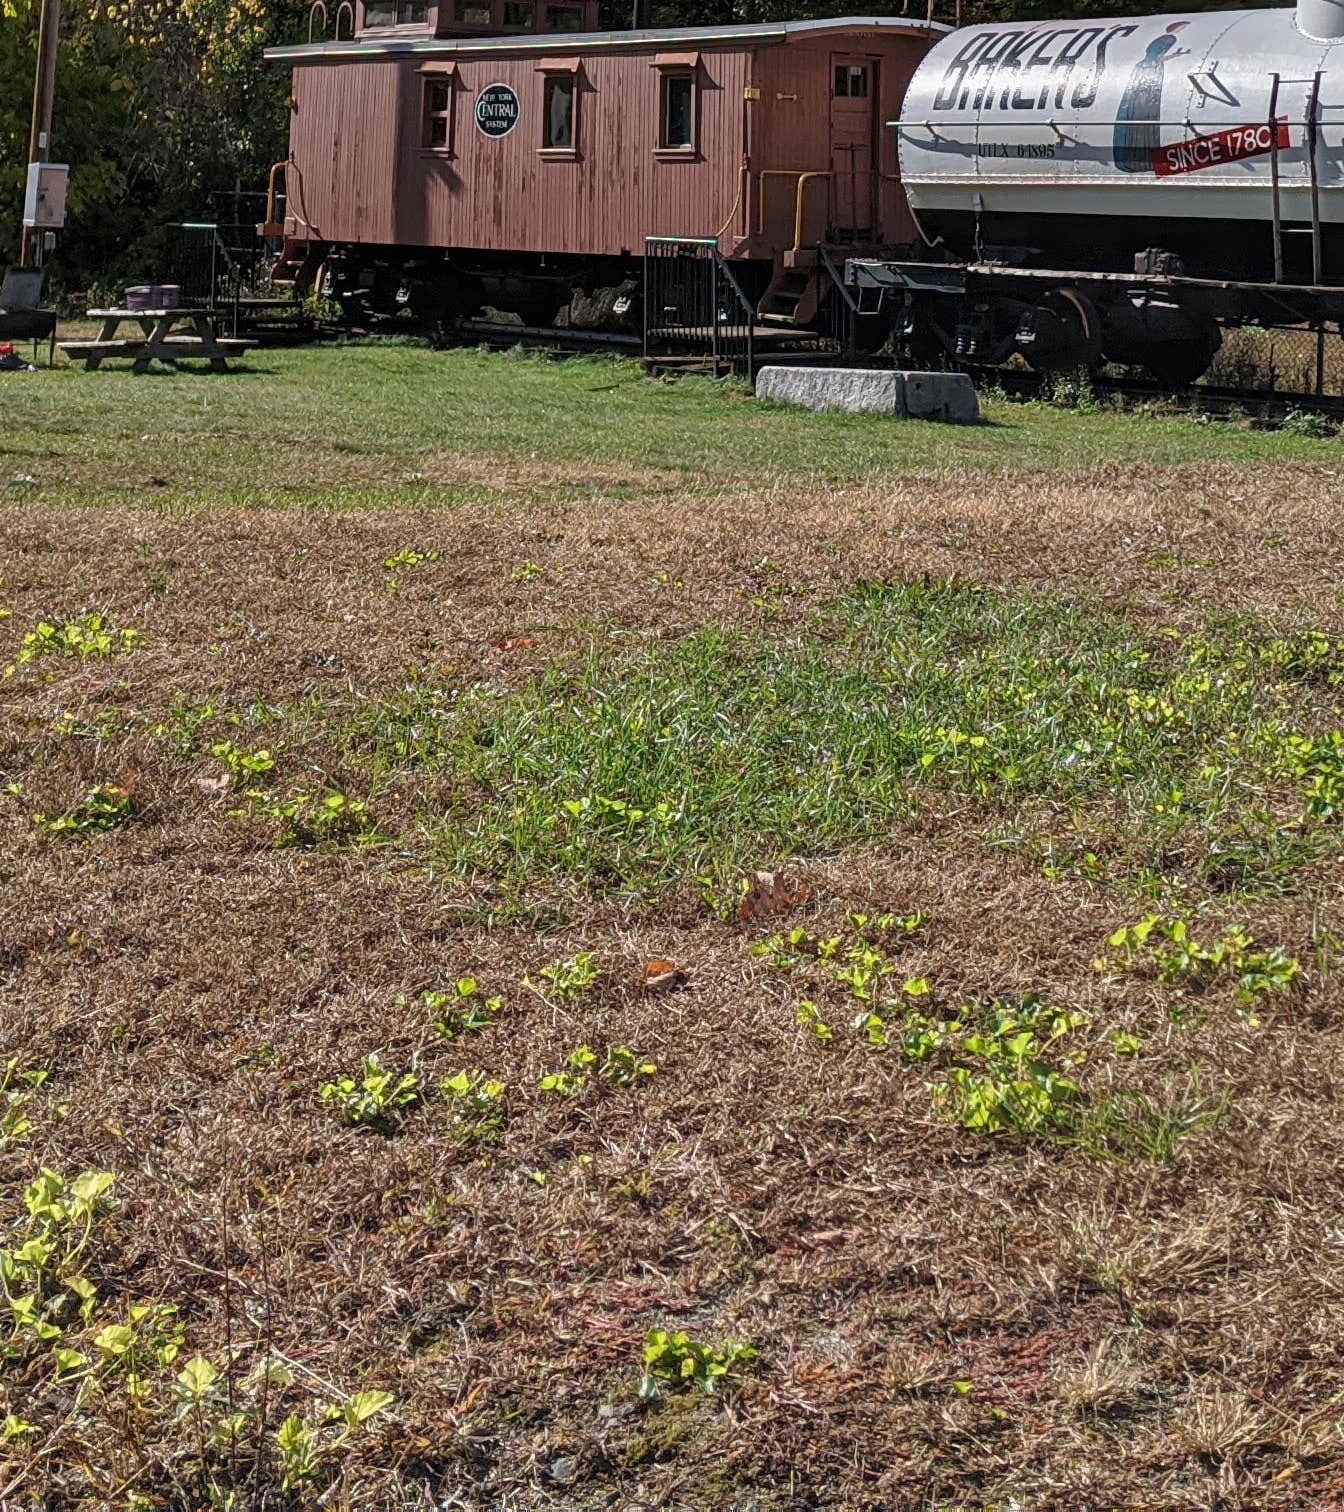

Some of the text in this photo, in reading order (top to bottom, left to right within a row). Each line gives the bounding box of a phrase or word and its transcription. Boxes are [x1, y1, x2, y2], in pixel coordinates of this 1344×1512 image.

[498, 93, 513, 101] YORK
[477, 100, 516, 121] CENTRAL
[486, 120, 508, 128] SYSTEM
[978, 143, 1009, 158] UTLX
[1166, 125, 1273, 171] SINCE 1780
